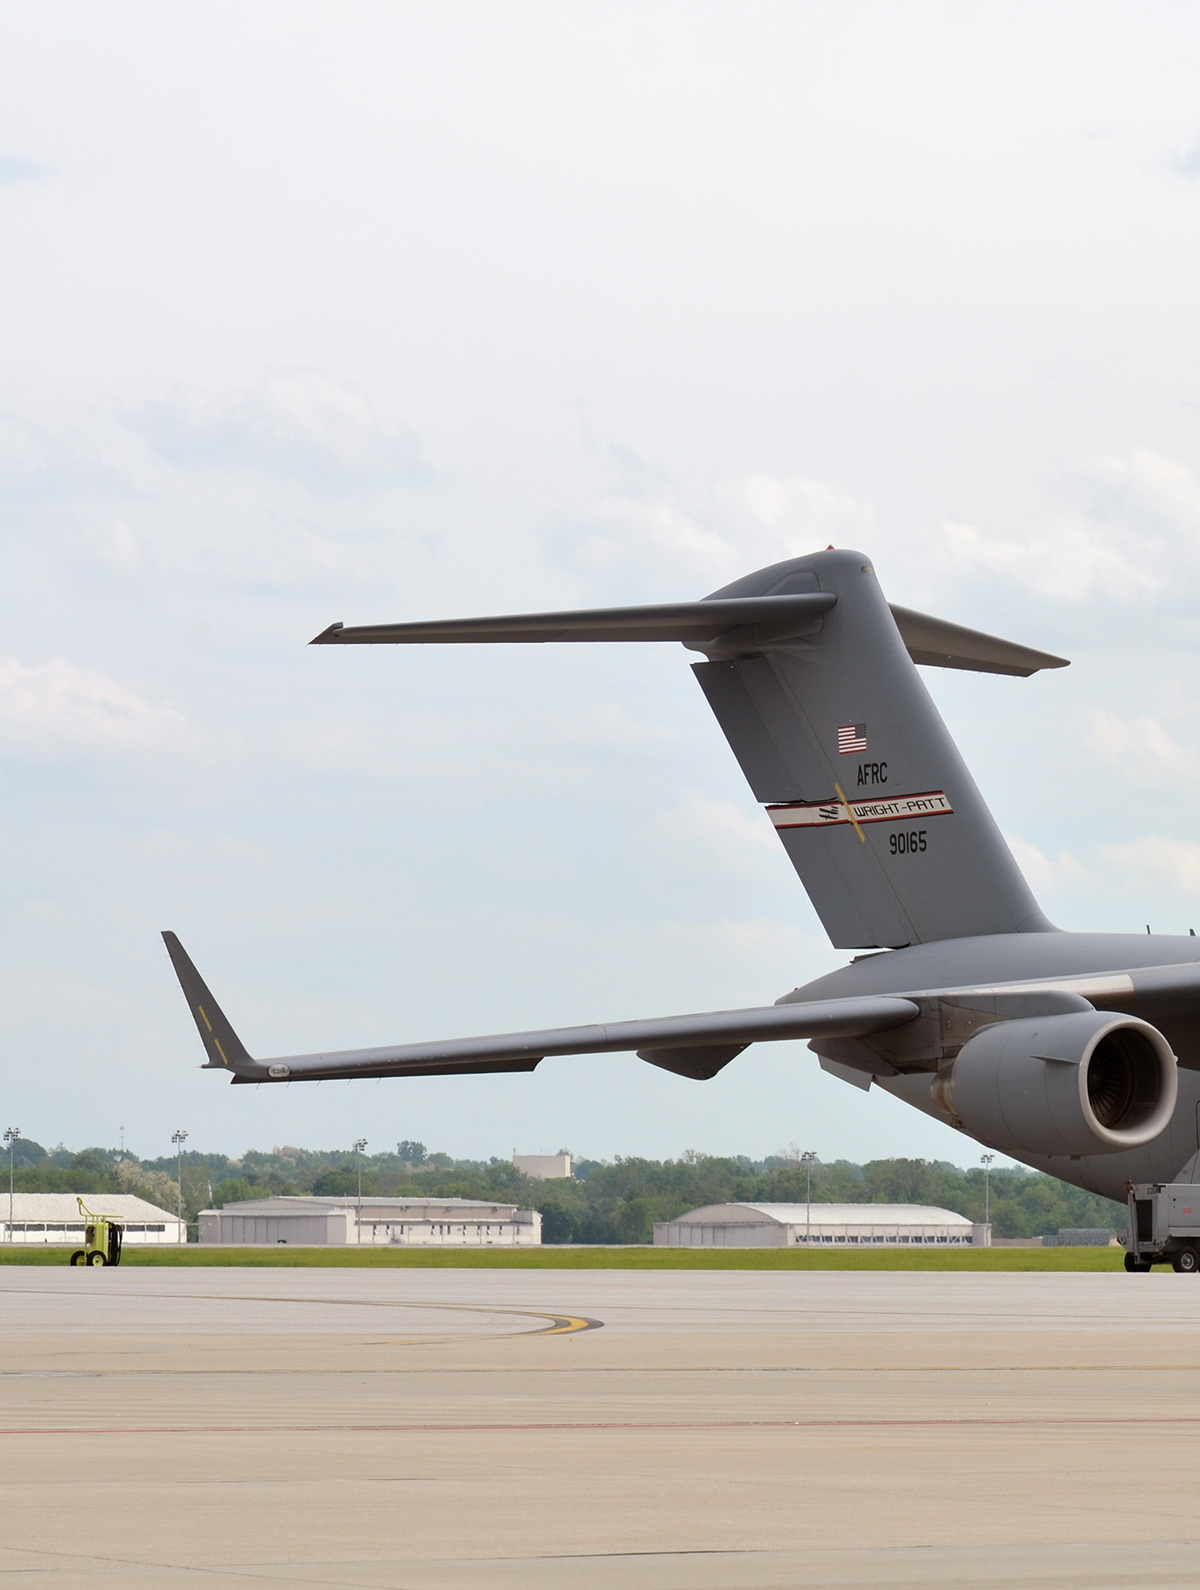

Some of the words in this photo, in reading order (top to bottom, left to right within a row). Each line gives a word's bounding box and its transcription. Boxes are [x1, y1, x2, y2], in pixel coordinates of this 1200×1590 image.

[857, 762, 888, 786] AFRC
[853, 797, 945, 817] WRIGHT-PATT
[889, 830, 927, 855] 90165
